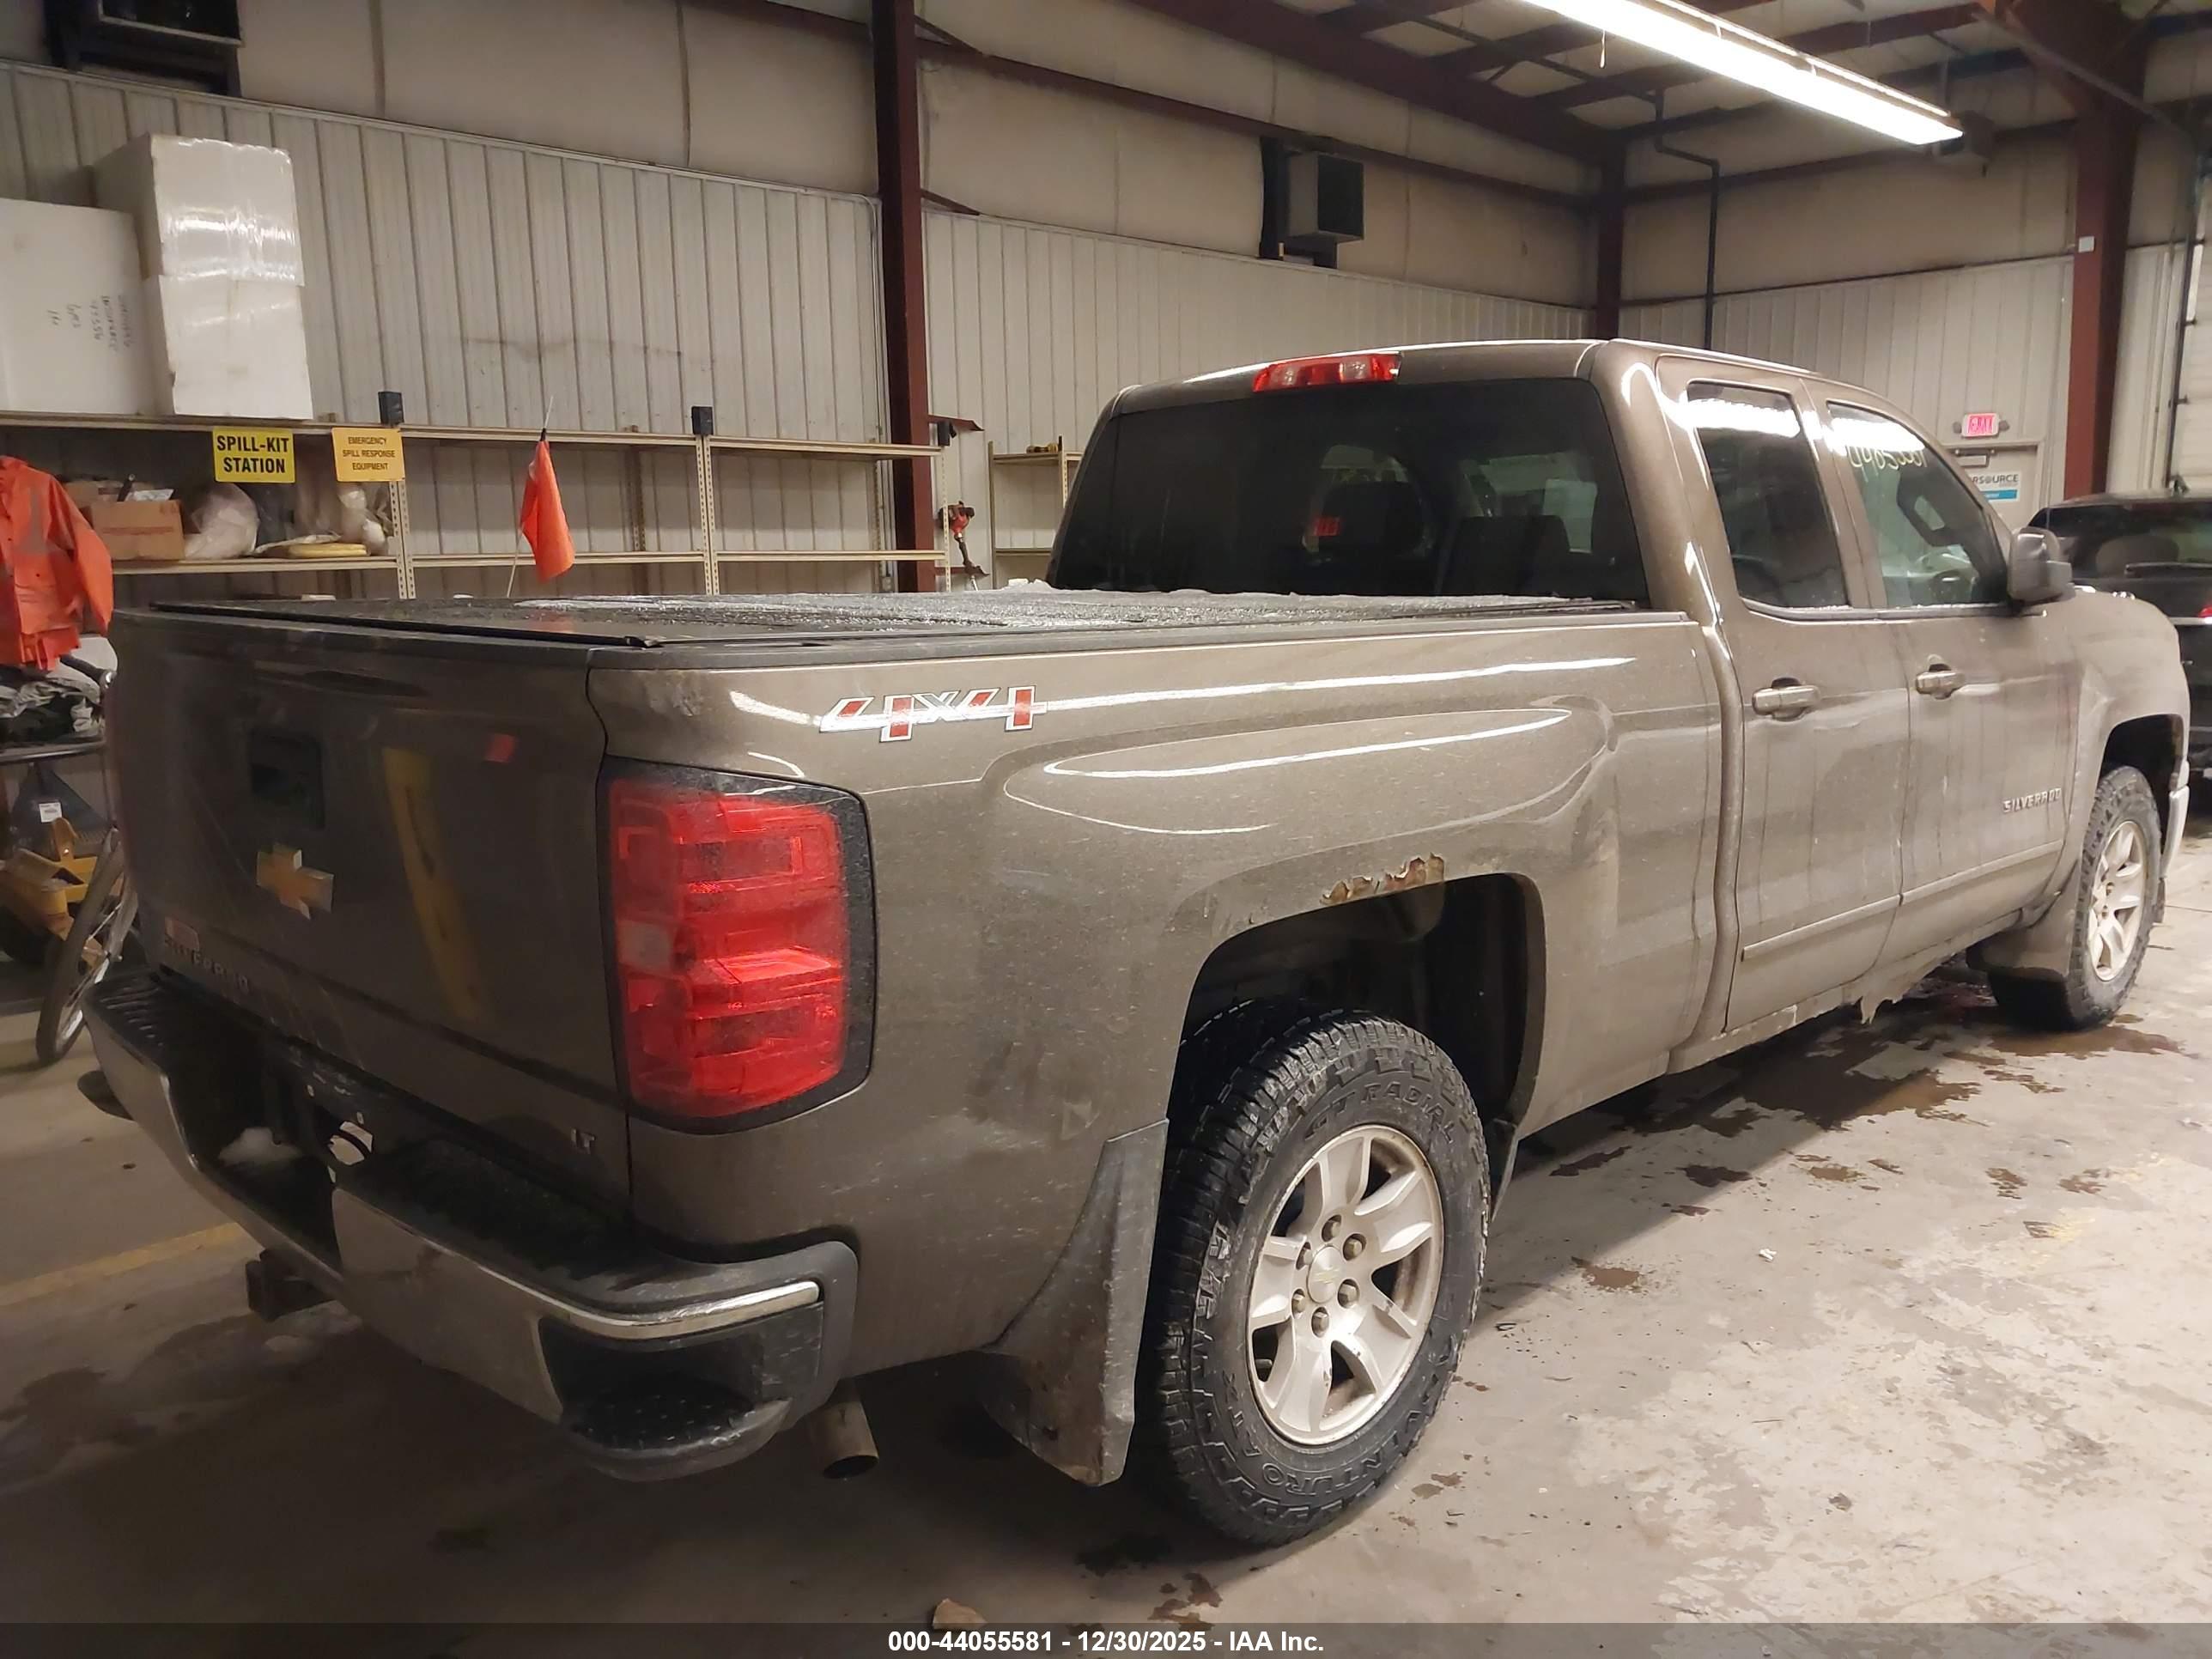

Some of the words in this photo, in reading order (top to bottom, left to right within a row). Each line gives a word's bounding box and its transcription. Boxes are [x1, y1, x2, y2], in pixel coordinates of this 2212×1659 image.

[216, 434, 289, 453] SPILL-KIT
[348, 436, 386, 445] EMERGENCY
[343, 449, 360, 458] SPILL
[362, 449, 395, 458] RESPONSE
[223, 457, 285, 473] STATION
[352, 462, 388, 471] EQUIPMENT
[2002, 787, 2062, 812] SILVERADO
[1360, 1080, 1455, 1145] RADIAL
